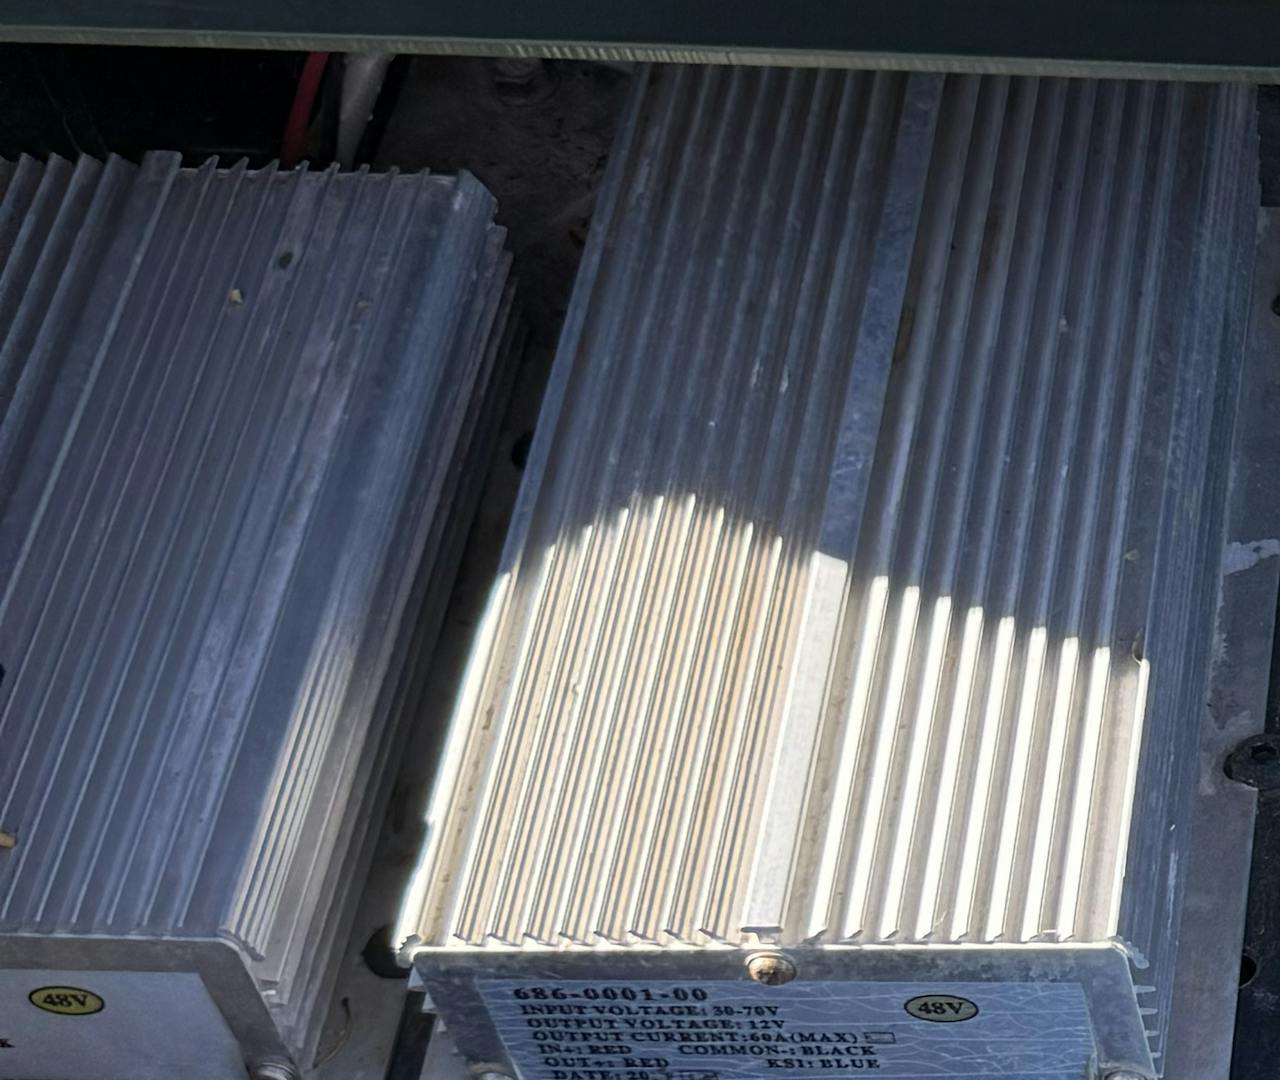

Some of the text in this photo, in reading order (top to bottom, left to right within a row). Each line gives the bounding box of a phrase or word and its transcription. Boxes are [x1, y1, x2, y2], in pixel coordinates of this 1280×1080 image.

[514, 988, 708, 1001] 686-0001-00
[42, 994, 89, 1008] 48V
[520, 1006, 586, 1015] INPUT
[592, 1006, 707, 1016] VOLTAGE:
[918, 1003, 963, 1014] 48V
[528, 1019, 784, 1029] OUTPUT VOLTAGE: 12V
[533, 1031, 622, 1042] OUTPUT
[588, 1045, 632, 1054] RED
[802, 1046, 876, 1055] BLACK
[624, 1058, 668, 1067] RED
[768, 1059, 880, 1068] KSI: BLUE
[553, 1071, 621, 1080] DATE:
